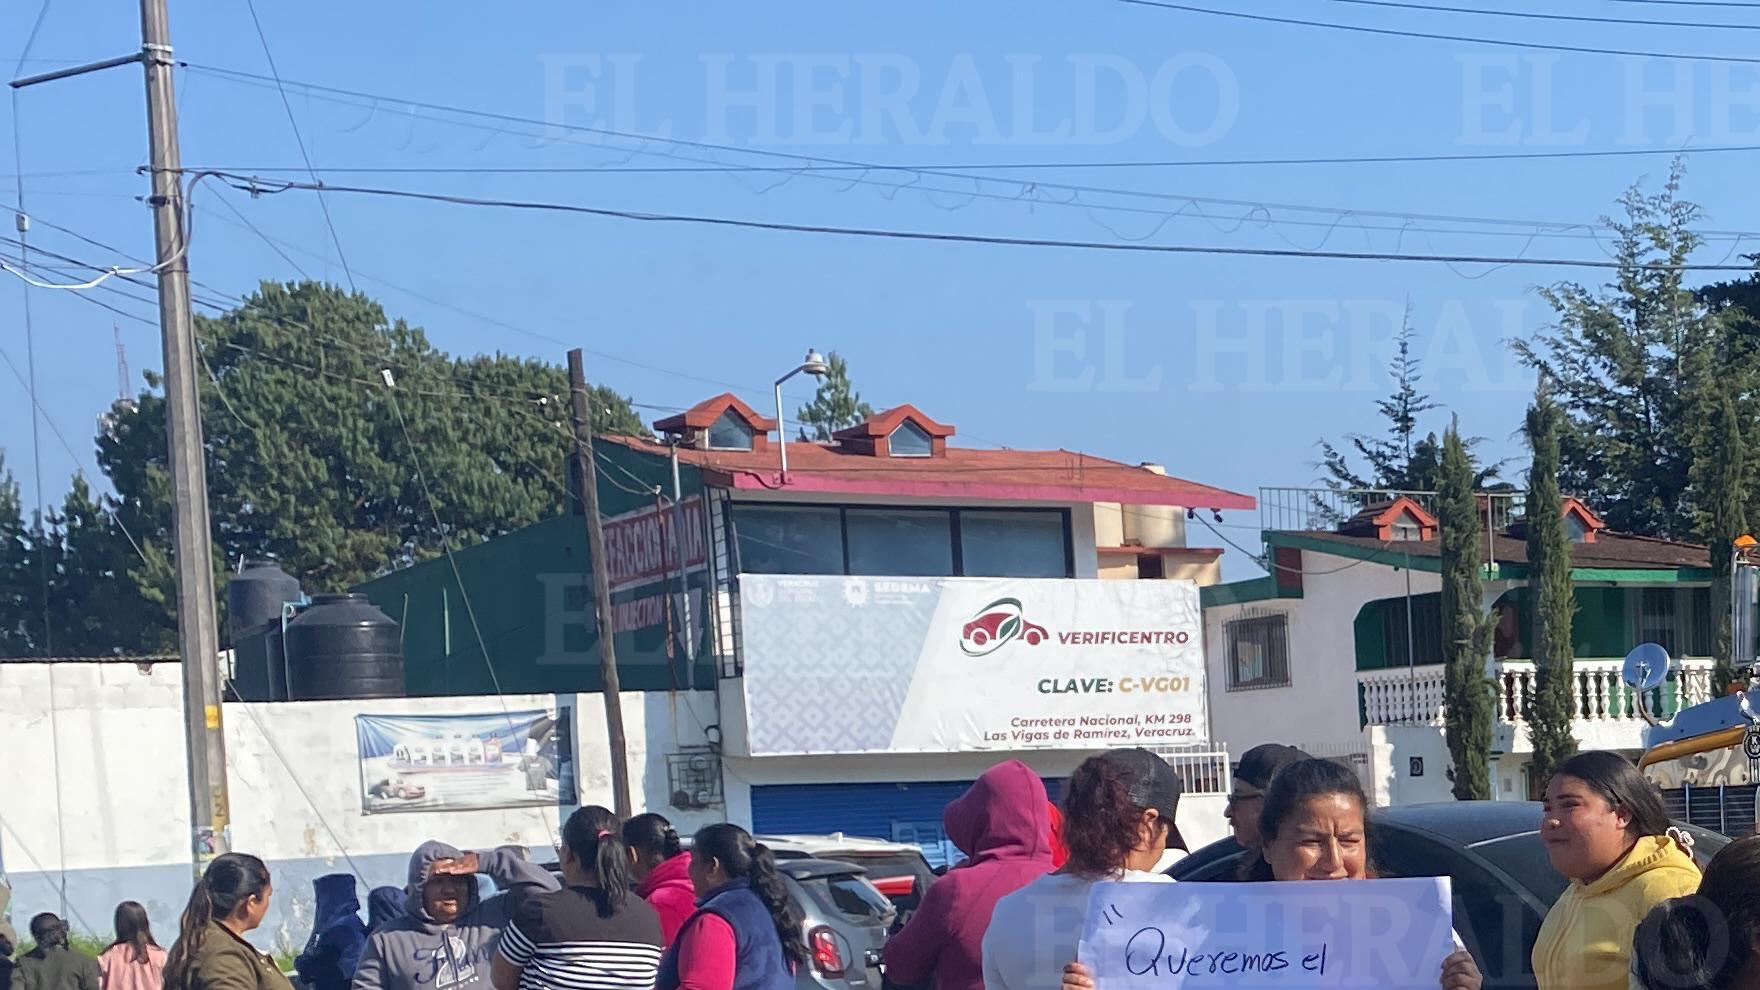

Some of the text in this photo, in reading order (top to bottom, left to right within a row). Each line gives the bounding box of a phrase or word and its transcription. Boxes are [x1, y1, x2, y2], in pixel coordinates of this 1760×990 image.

[1058, 631, 1189, 645] VERIFICENTRO
[1038, 677, 1190, 694] CLAVE: C-VG01
[1011, 713, 1192, 728] Carretera Nacional, KM 298
[984, 731, 1009, 742] Las
[1011, 729, 1050, 743] Vigas
[1053, 729, 1070, 741] de
[1301, 943, 1327, 976] el
